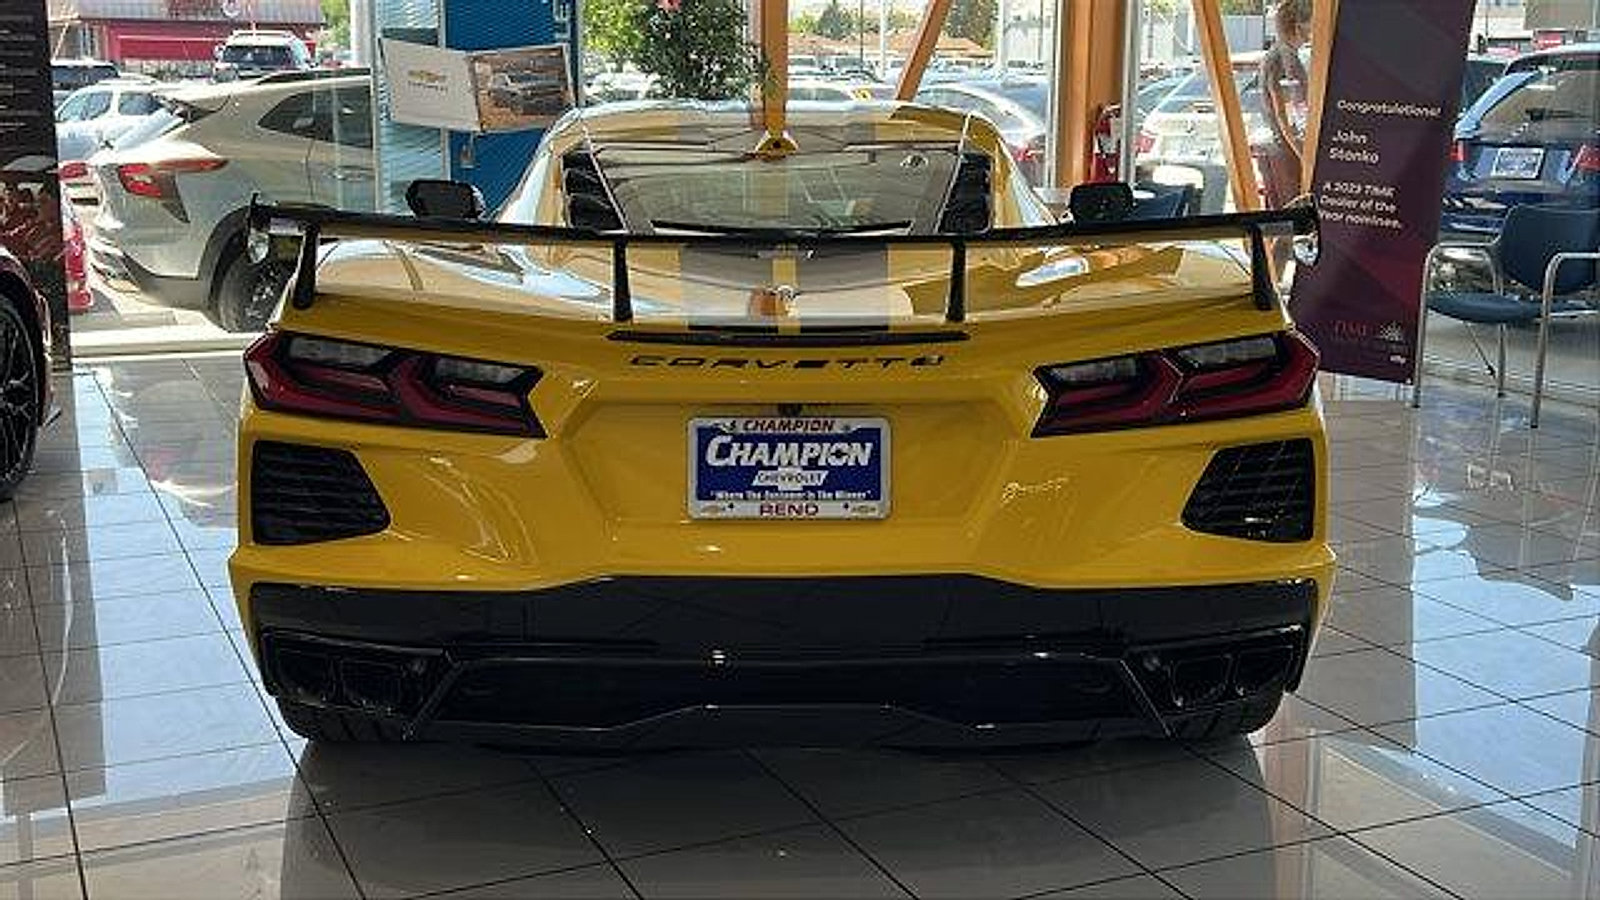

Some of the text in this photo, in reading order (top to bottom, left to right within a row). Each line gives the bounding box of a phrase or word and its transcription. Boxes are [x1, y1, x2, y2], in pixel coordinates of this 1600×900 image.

[1337, 99, 1442, 117] Congratulations!
[1332, 130, 1368, 144] John
[1329, 147, 1380, 164] Stanko
[1360, 200, 1374, 210] of
[1375, 201, 1397, 213] the
[743, 418, 835, 432] CHAMPION
[760, 502, 820, 517] RENO
